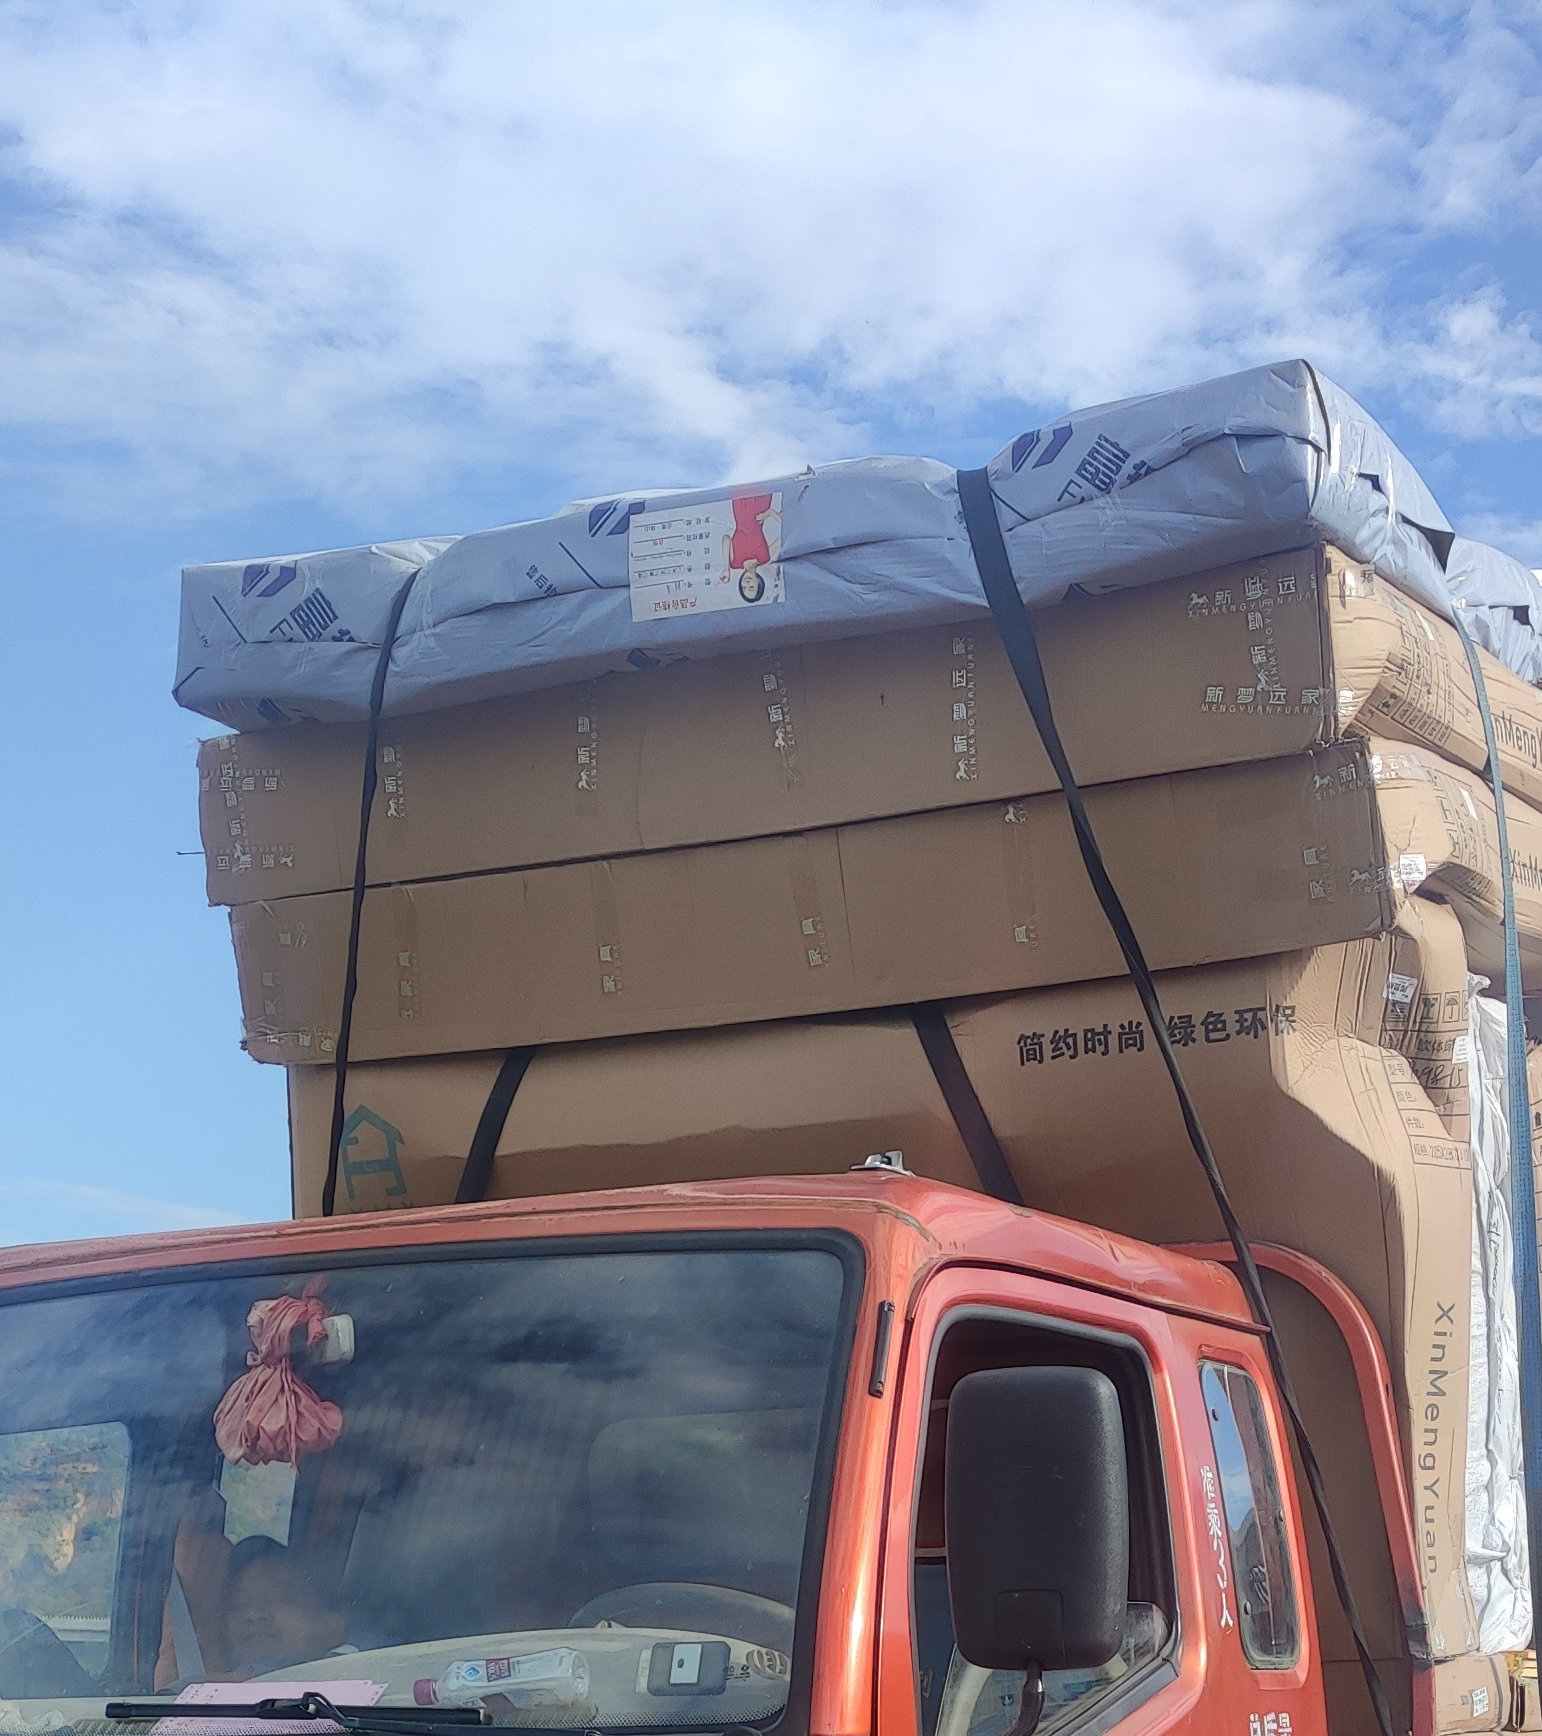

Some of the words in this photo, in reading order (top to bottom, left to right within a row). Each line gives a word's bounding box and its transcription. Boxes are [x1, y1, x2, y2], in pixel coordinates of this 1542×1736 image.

[1016, 1019, 1145, 1067] 简约时尚
[1165, 1003, 1298, 1048] 绿色环保
[1418, 1301, 1457, 1574] XinMengYuan
